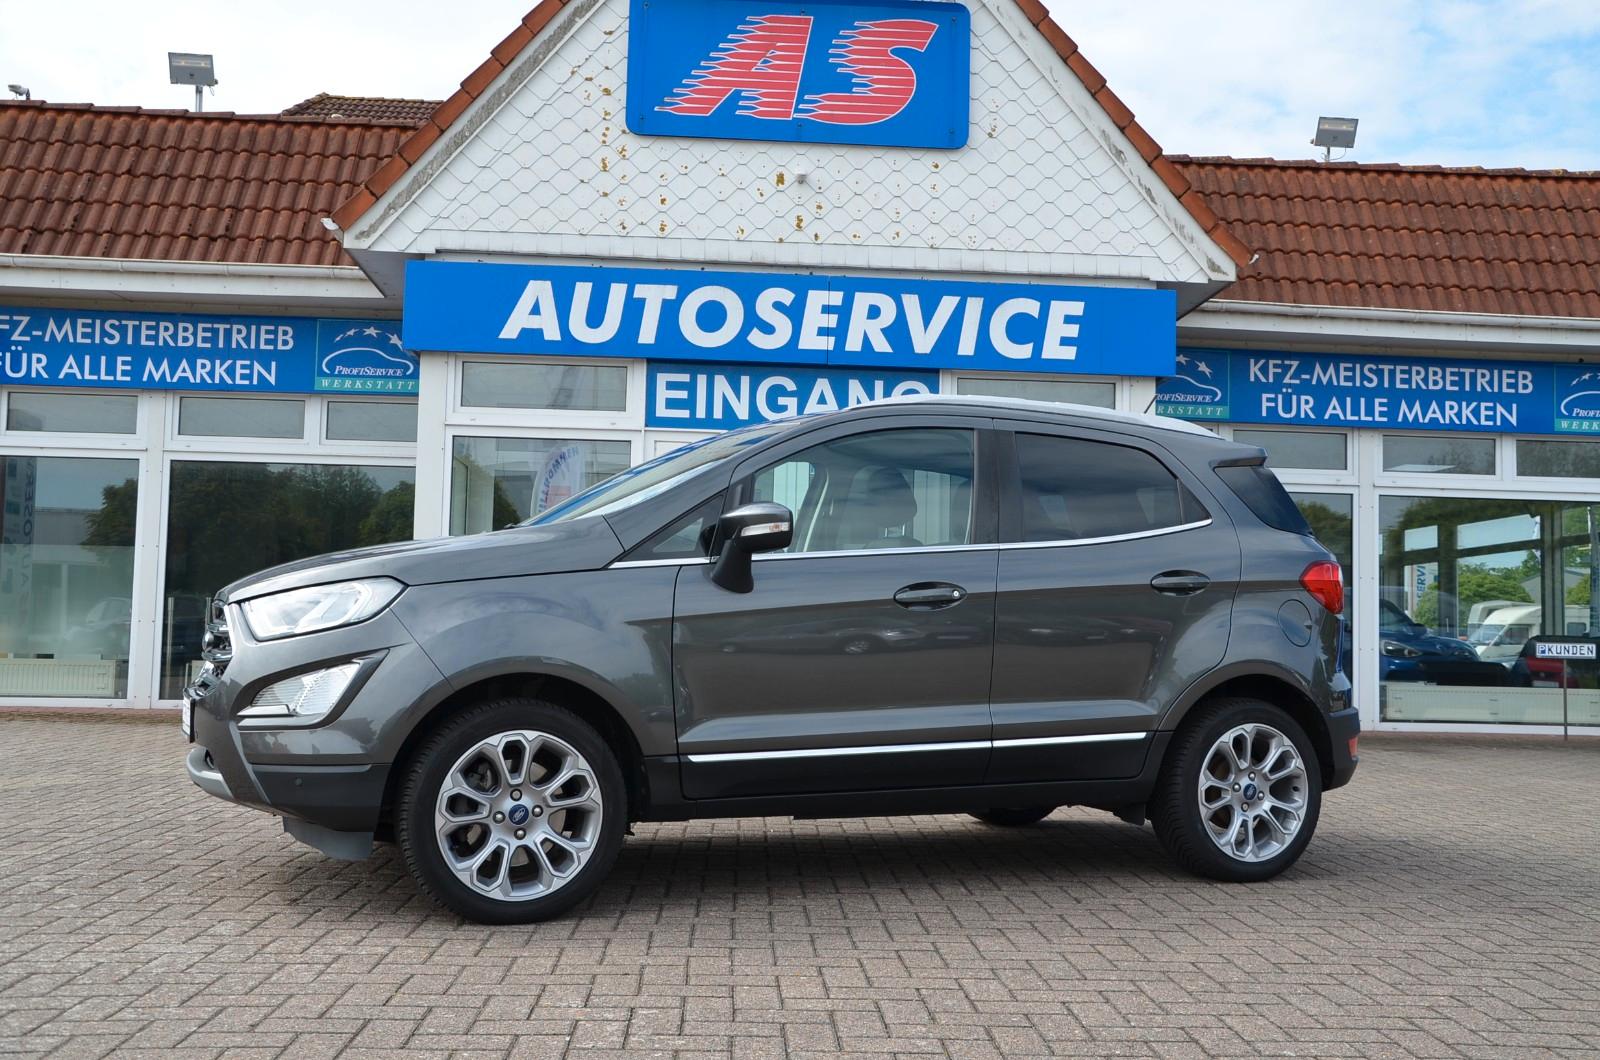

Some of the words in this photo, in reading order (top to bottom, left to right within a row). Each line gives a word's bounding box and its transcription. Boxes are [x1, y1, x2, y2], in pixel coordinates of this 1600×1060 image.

[654, 14, 939, 125] AS
[498, 279, 1085, 361] AUTOSERVICE
[0, 345, 49, 379] ÜR
[58, 354, 132, 381] ALLE
[142, 357, 277, 386] MARKEN
[1249, 358, 1533, 394] KFZ-MEISTERBETRIEB
[321, 379, 415, 391] WERKSTATT
[1156, 393, 1213, 403] ROFISERVICE
[1156, 404, 1224, 416] RKSTATT
[1261, 388, 1316, 419] FÜR
[1324, 396, 1388, 422] ALLE
[1397, 399, 1517, 427] MARKEN
[1547, 644, 1594, 656] KUNDEN
